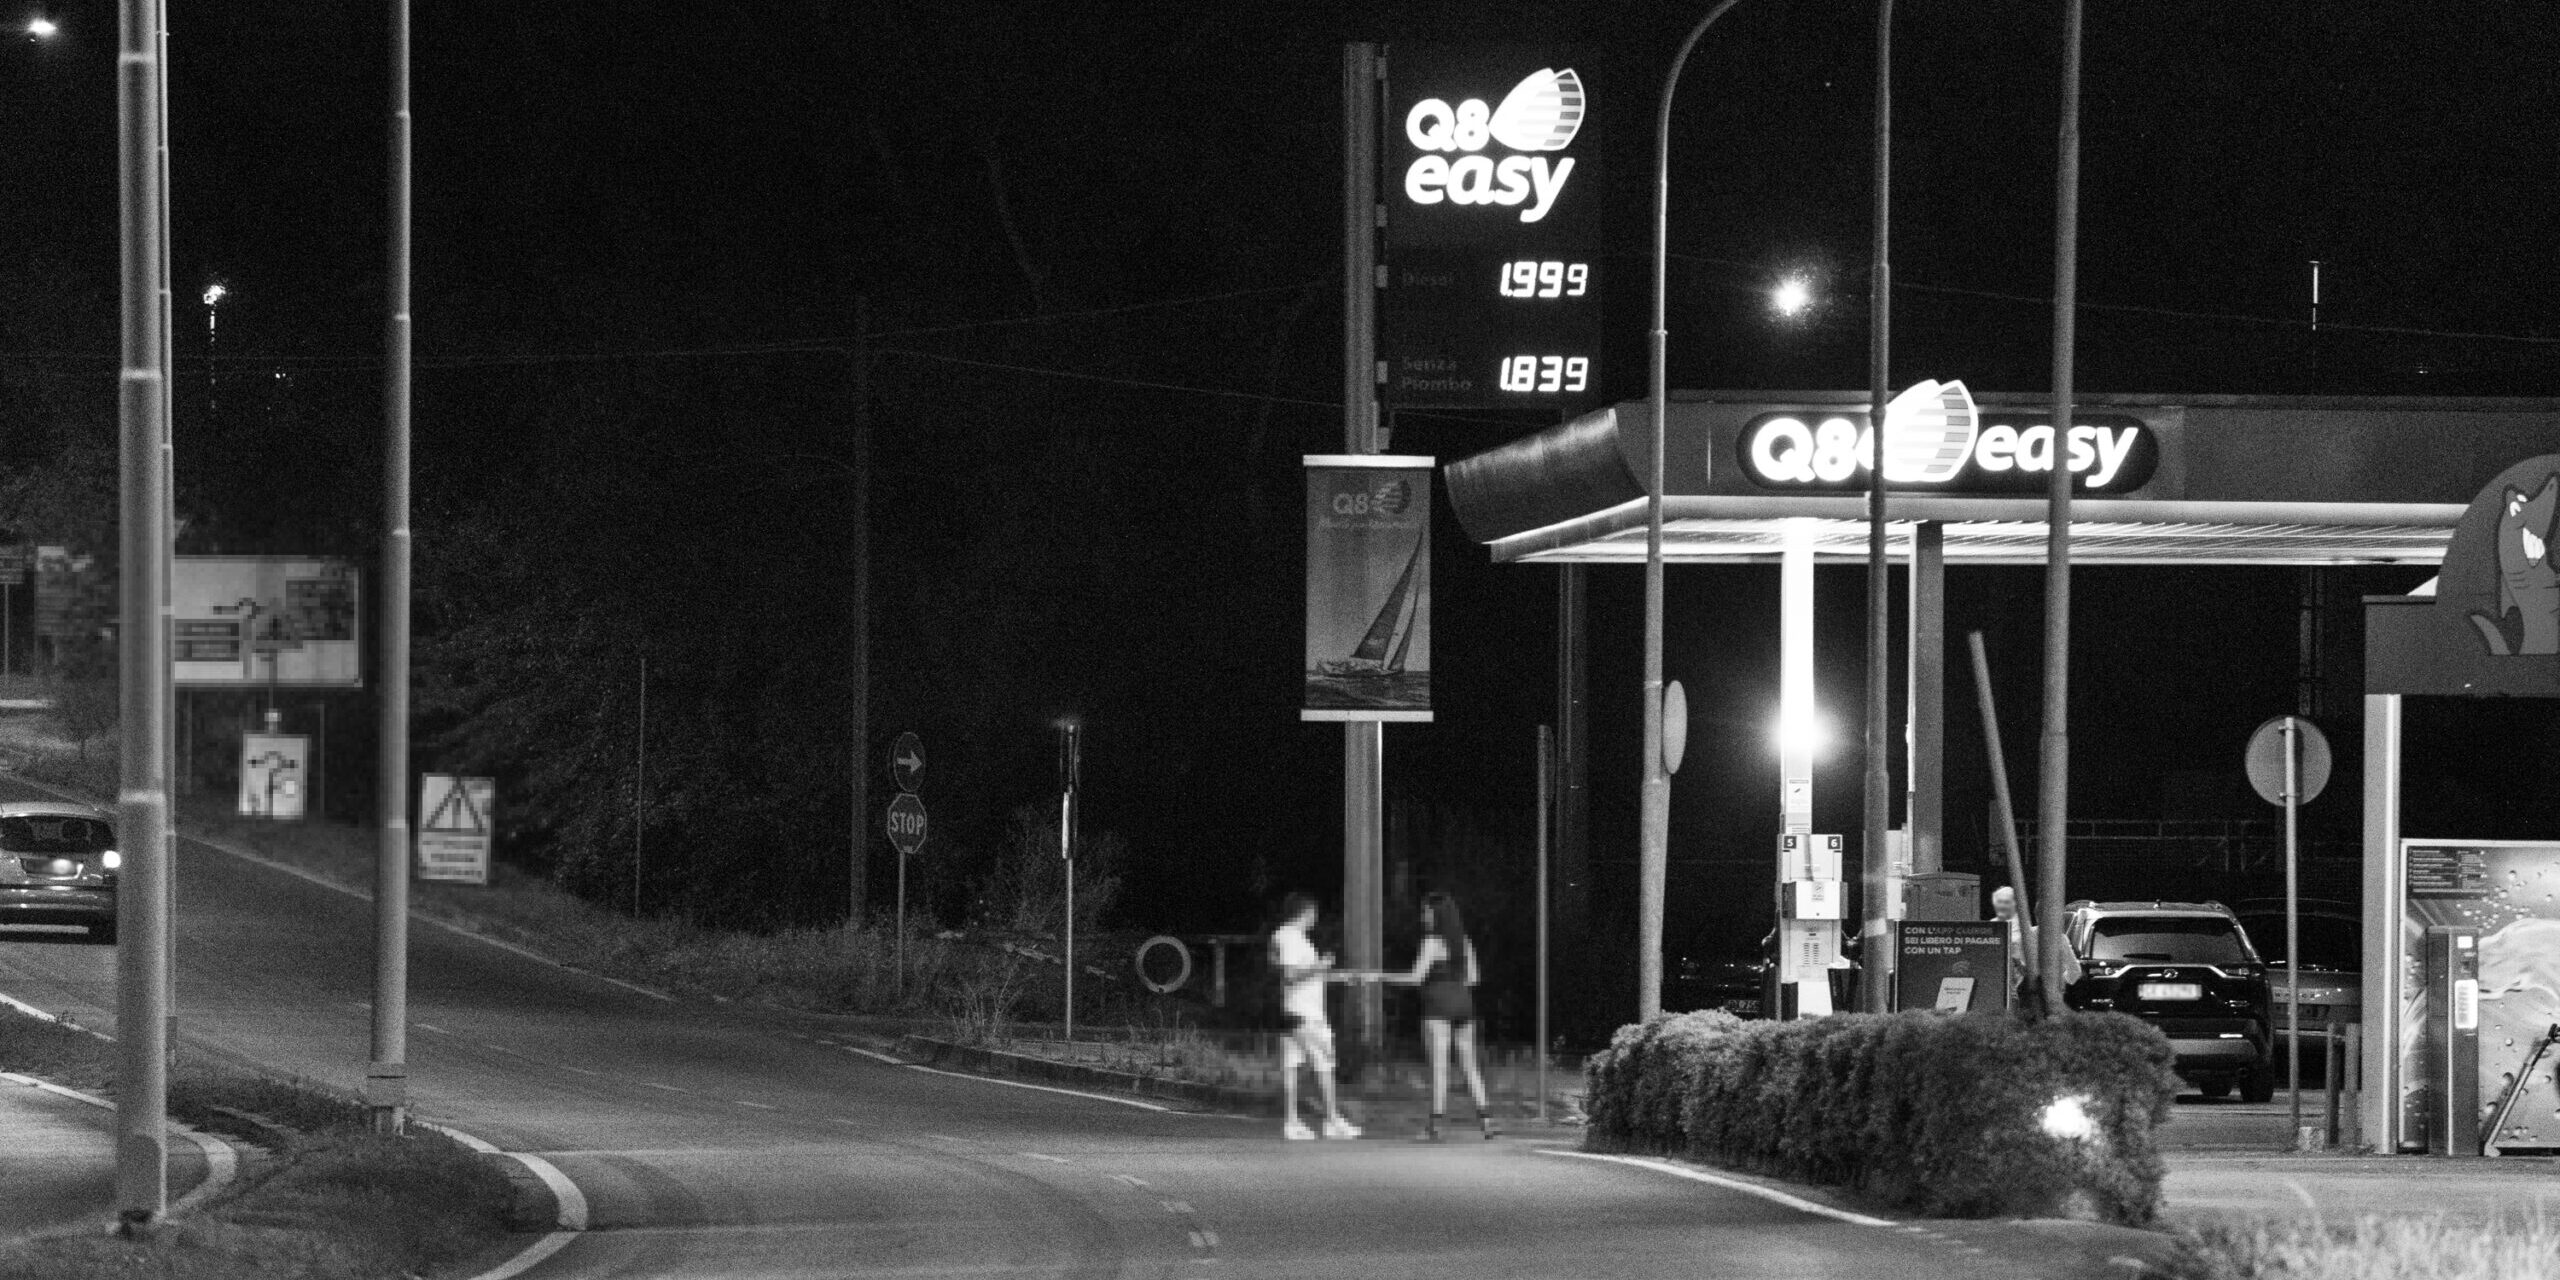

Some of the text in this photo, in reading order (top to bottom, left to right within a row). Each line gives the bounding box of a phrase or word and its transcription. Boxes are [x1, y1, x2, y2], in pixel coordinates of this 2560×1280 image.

[1405, 98, 1490, 152] Q8
[1405, 155, 1576, 222] easy
[1500, 261, 1588, 297] 1.999
[1402, 376, 1472, 390] Piombo
[1500, 355, 1588, 391] 1.839
[1751, 417, 2138, 488] Q8 easy
[1333, 493, 1369, 514] Q8
[891, 811, 924, 835] STOP
[1786, 838, 1794, 847] 5
[1831, 838, 1838, 847] 6
[1904, 926, 1926, 934] CON
[1904, 936, 2001, 945] SEI LIBERO DI PAGARE
[1904, 946, 1962, 954] CON UN TAP
